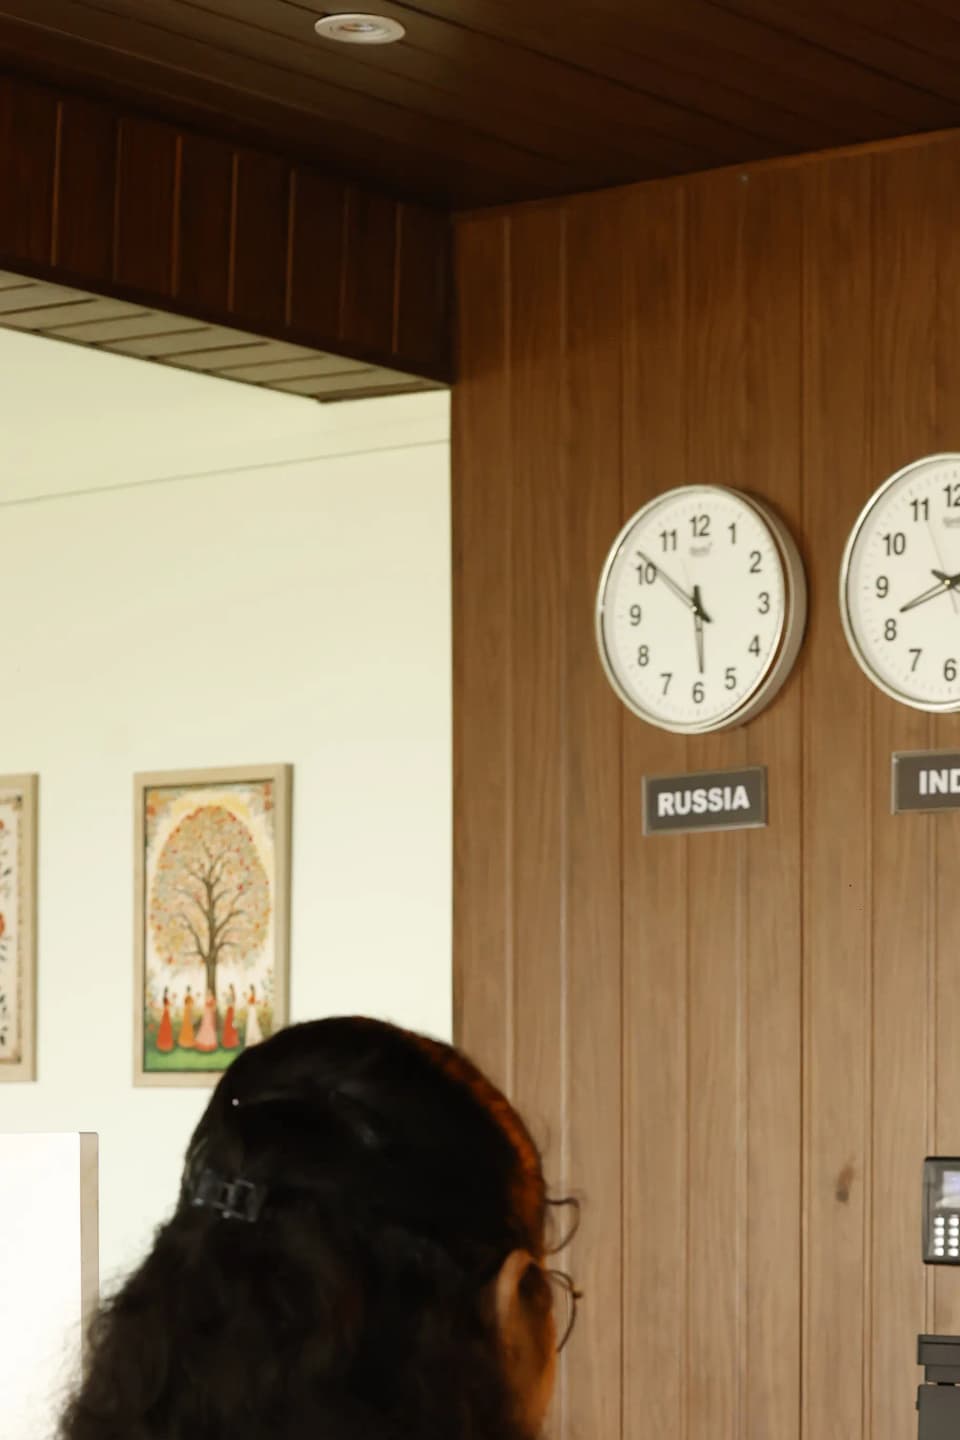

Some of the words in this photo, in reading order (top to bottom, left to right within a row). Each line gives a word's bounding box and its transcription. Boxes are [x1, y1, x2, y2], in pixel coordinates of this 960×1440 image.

[910, 497, 929, 522] 11
[689, 514, 711, 537] 12
[728, 522, 736, 545] 1
[659, 529, 677, 552] 11
[882, 532, 906, 556] 10
[635, 562, 657, 585] 10
[749, 550, 762, 574] 2
[875, 575, 889, 599] 9
[758, 591, 770, 615] 3
[629, 604, 642, 627] 9
[884, 618, 897, 642] 8
[637, 644, 649, 667] 8
[748, 635, 761, 657] 4
[908, 648, 923, 672] 7
[943, 658, 957, 682] 6
[660, 672, 673, 695] 7
[725, 667, 737, 690] 5
[692, 681, 705, 704] 6
[657, 785, 751, 818] RUSSIA
